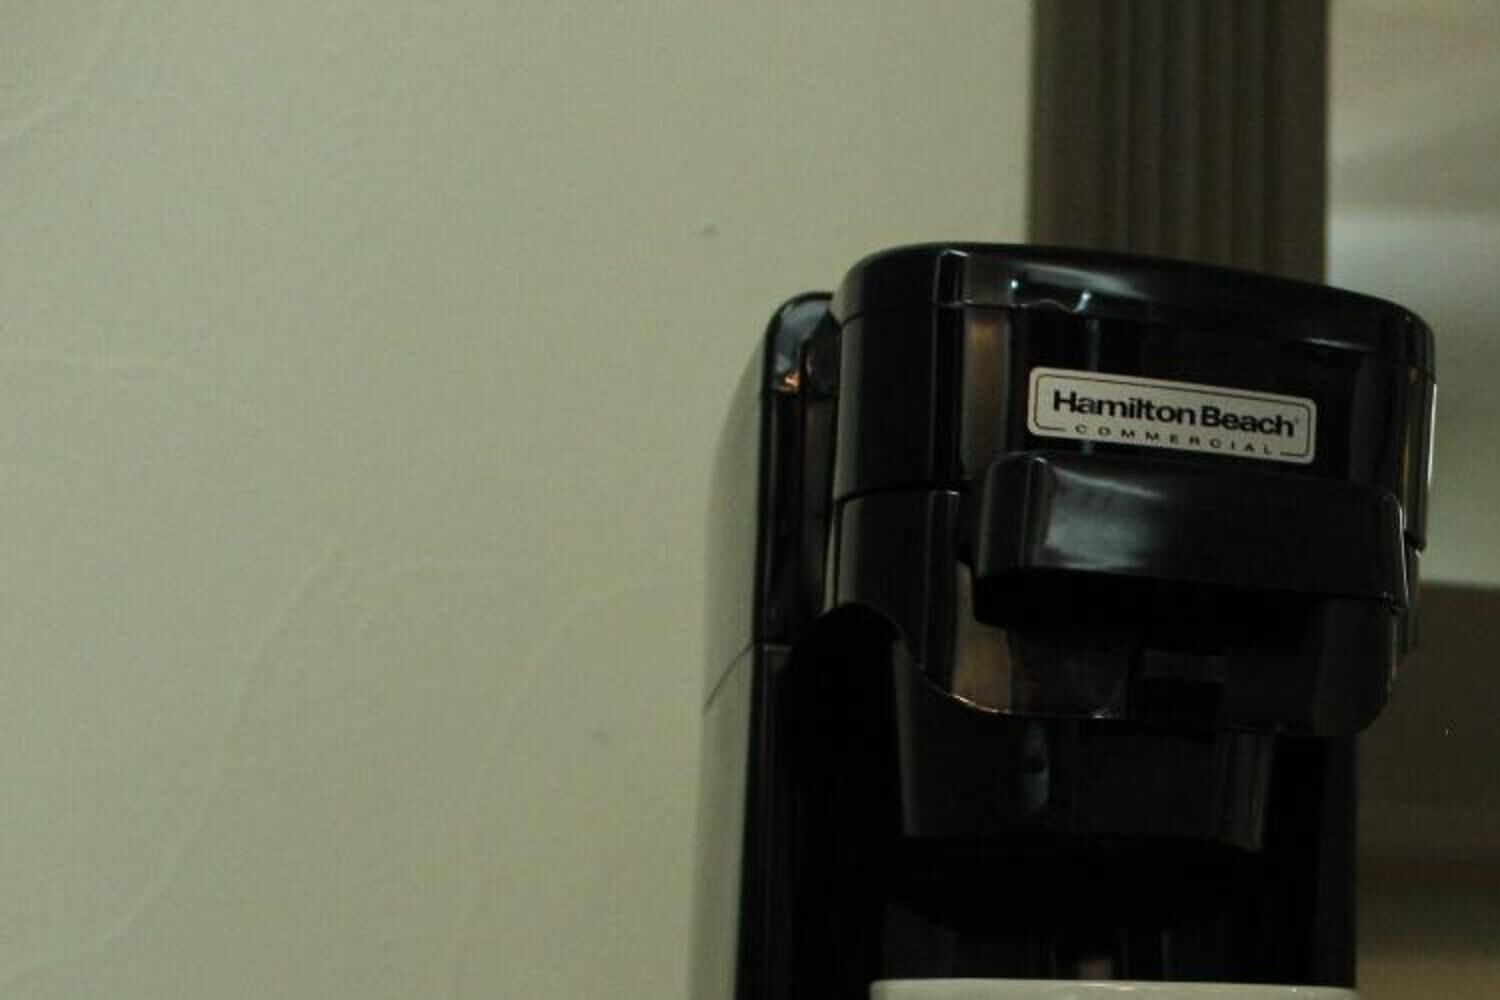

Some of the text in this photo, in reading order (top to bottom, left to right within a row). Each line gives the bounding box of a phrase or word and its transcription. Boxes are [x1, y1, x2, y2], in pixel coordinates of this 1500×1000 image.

[1052, 389, 1296, 438] Hamilton Beach
[1074, 423, 1273, 456] COMMERCIAL
